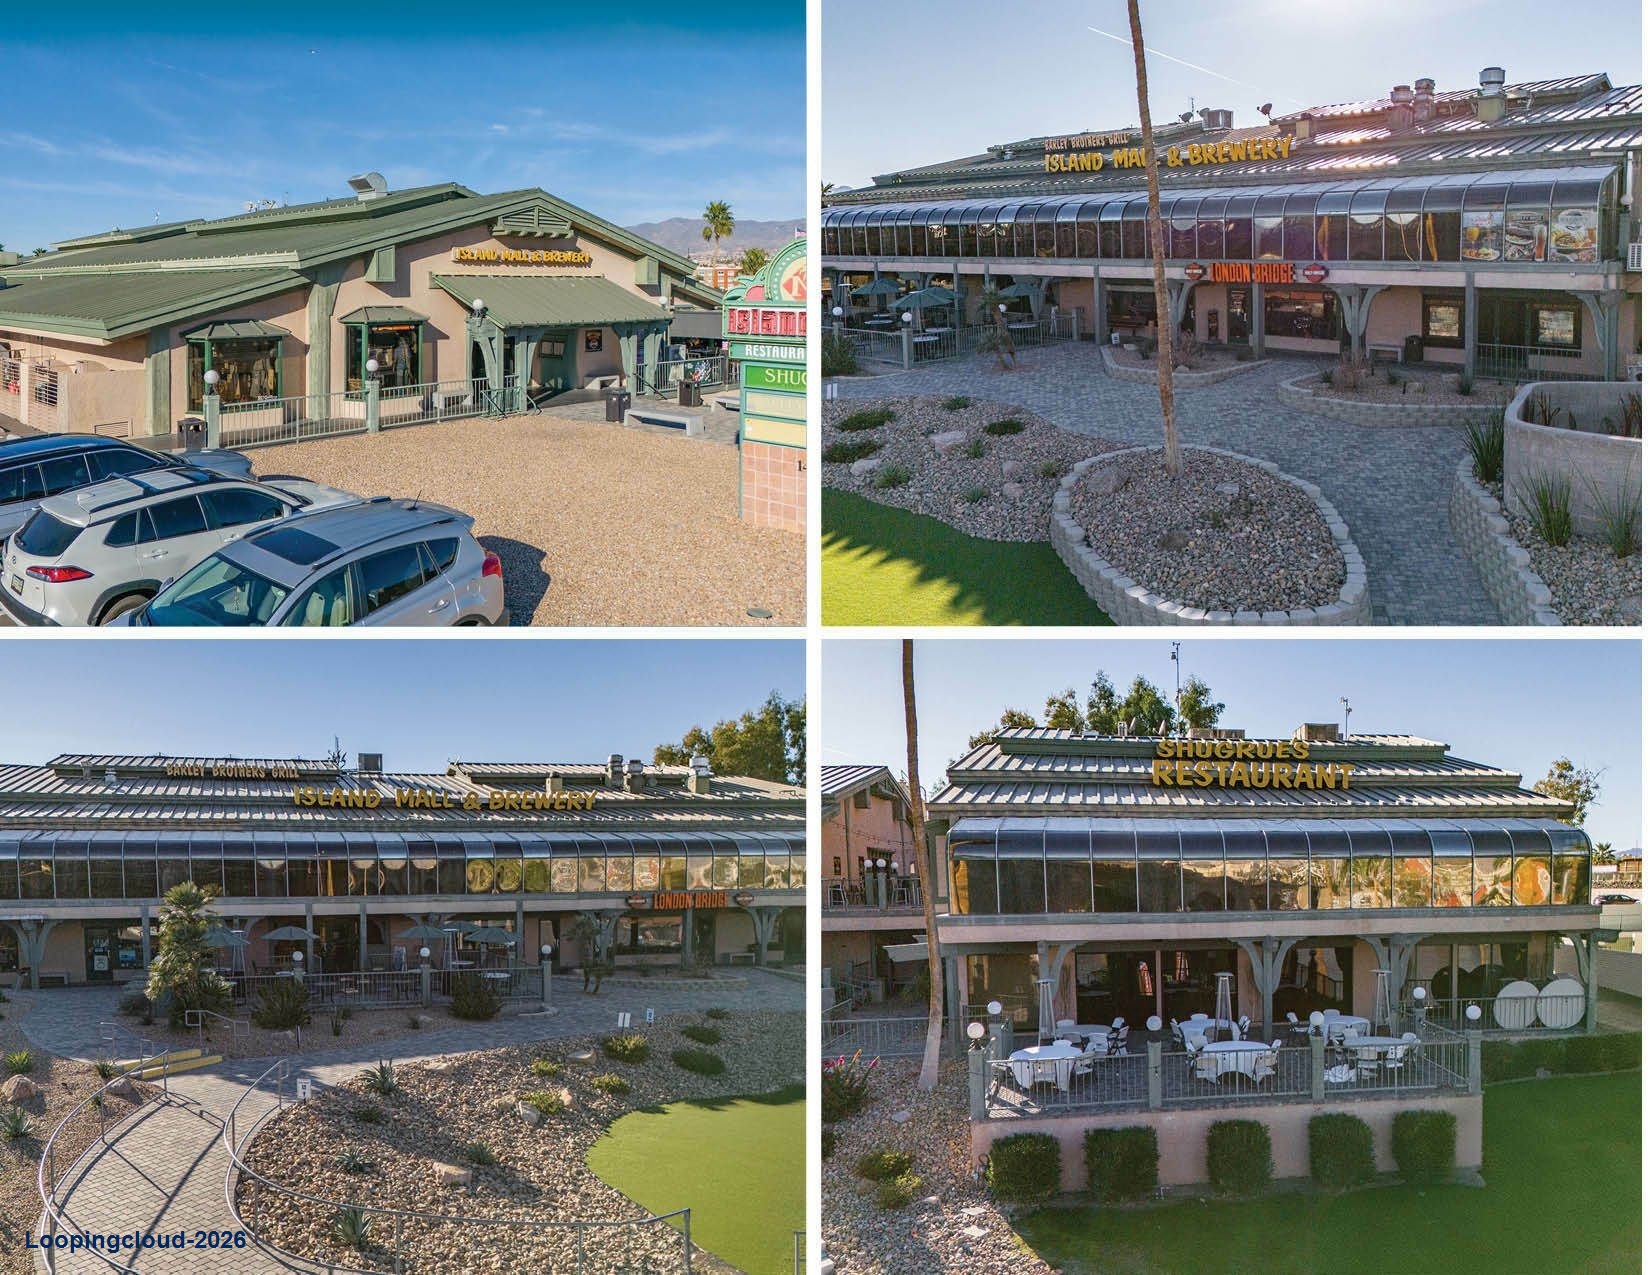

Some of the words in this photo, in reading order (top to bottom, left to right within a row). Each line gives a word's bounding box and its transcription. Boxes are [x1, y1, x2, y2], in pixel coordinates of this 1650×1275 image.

[1044, 152, 1104, 172] ISLAND
[1167, 146, 1183, 167] &
[1187, 133, 1292, 165] BREWERY
[457, 248, 498, 260] ISLAND
[501, 249, 529, 261] MALL
[531, 251, 542, 262] &
[543, 251, 591, 263] BREWERY
[1210, 263, 1252, 281] LONDON
[1253, 263, 1294, 284] BRIDGE
[1156, 737, 1310, 760] SHUGRUE'S
[166, 764, 205, 777] BARLEY
[212, 765, 266, 778] BROTHERS
[271, 767, 300, 778] GRILL
[1151, 760, 1354, 791] RESTAURANT
[294, 786, 382, 810] ISLAND
[395, 788, 456, 809] MALL
[462, 791, 481, 810] &
[488, 789, 599, 811] BREWERY
[654, 893, 693, 910] LONDON
[695, 892, 728, 908] BRIDGE
